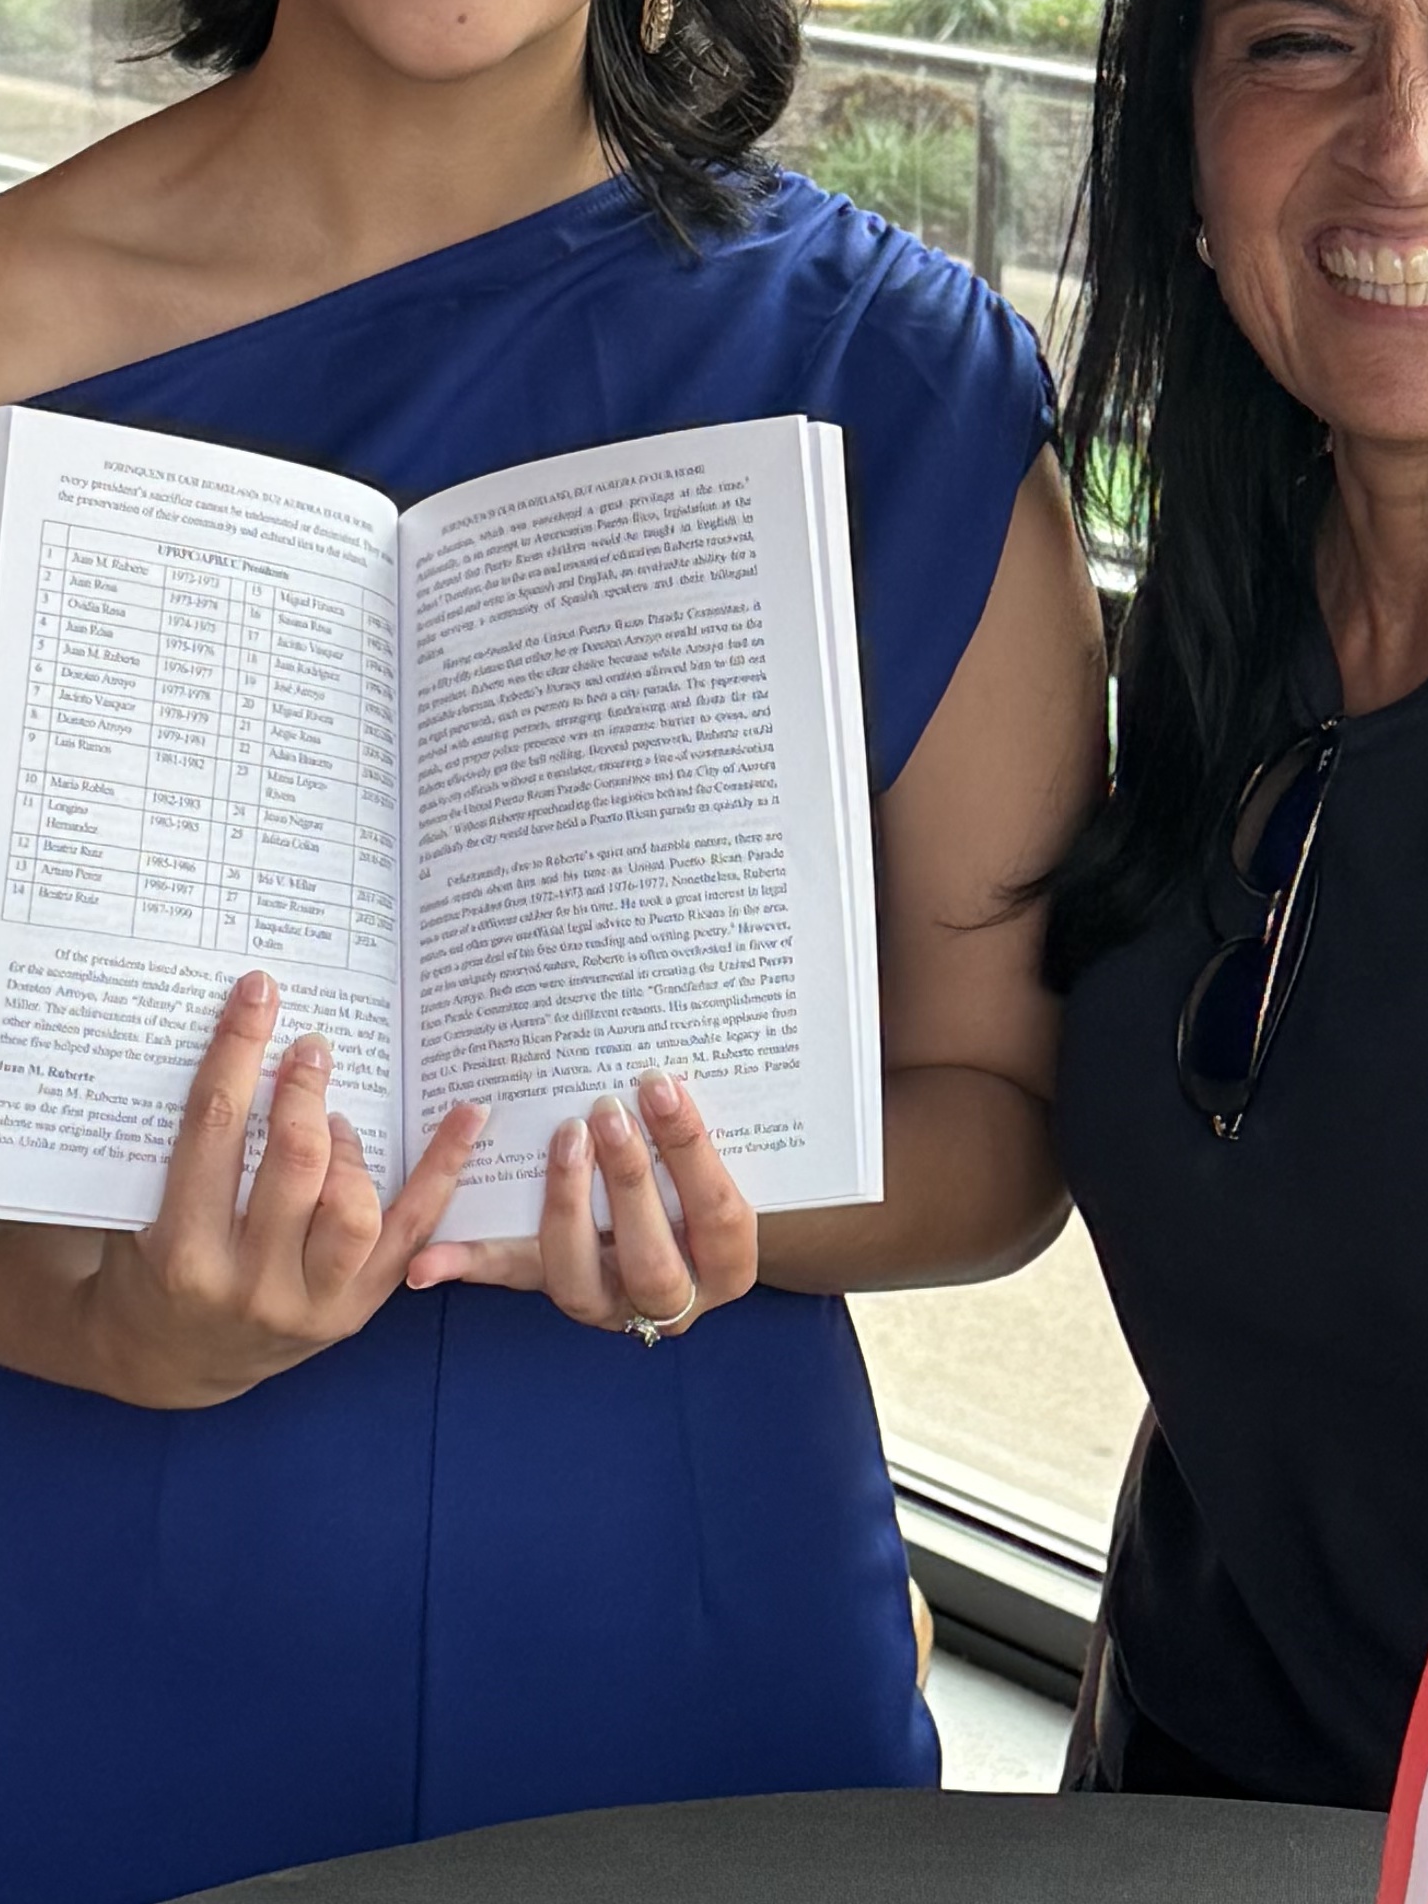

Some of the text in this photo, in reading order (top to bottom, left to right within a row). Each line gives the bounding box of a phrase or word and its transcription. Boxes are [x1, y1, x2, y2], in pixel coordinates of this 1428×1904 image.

[72, 952, 88, 962] the
[46, 1002, 65, 1015] The
[144, 1015, 156, 1025] of
[141, 1116, 153, 1126] of
